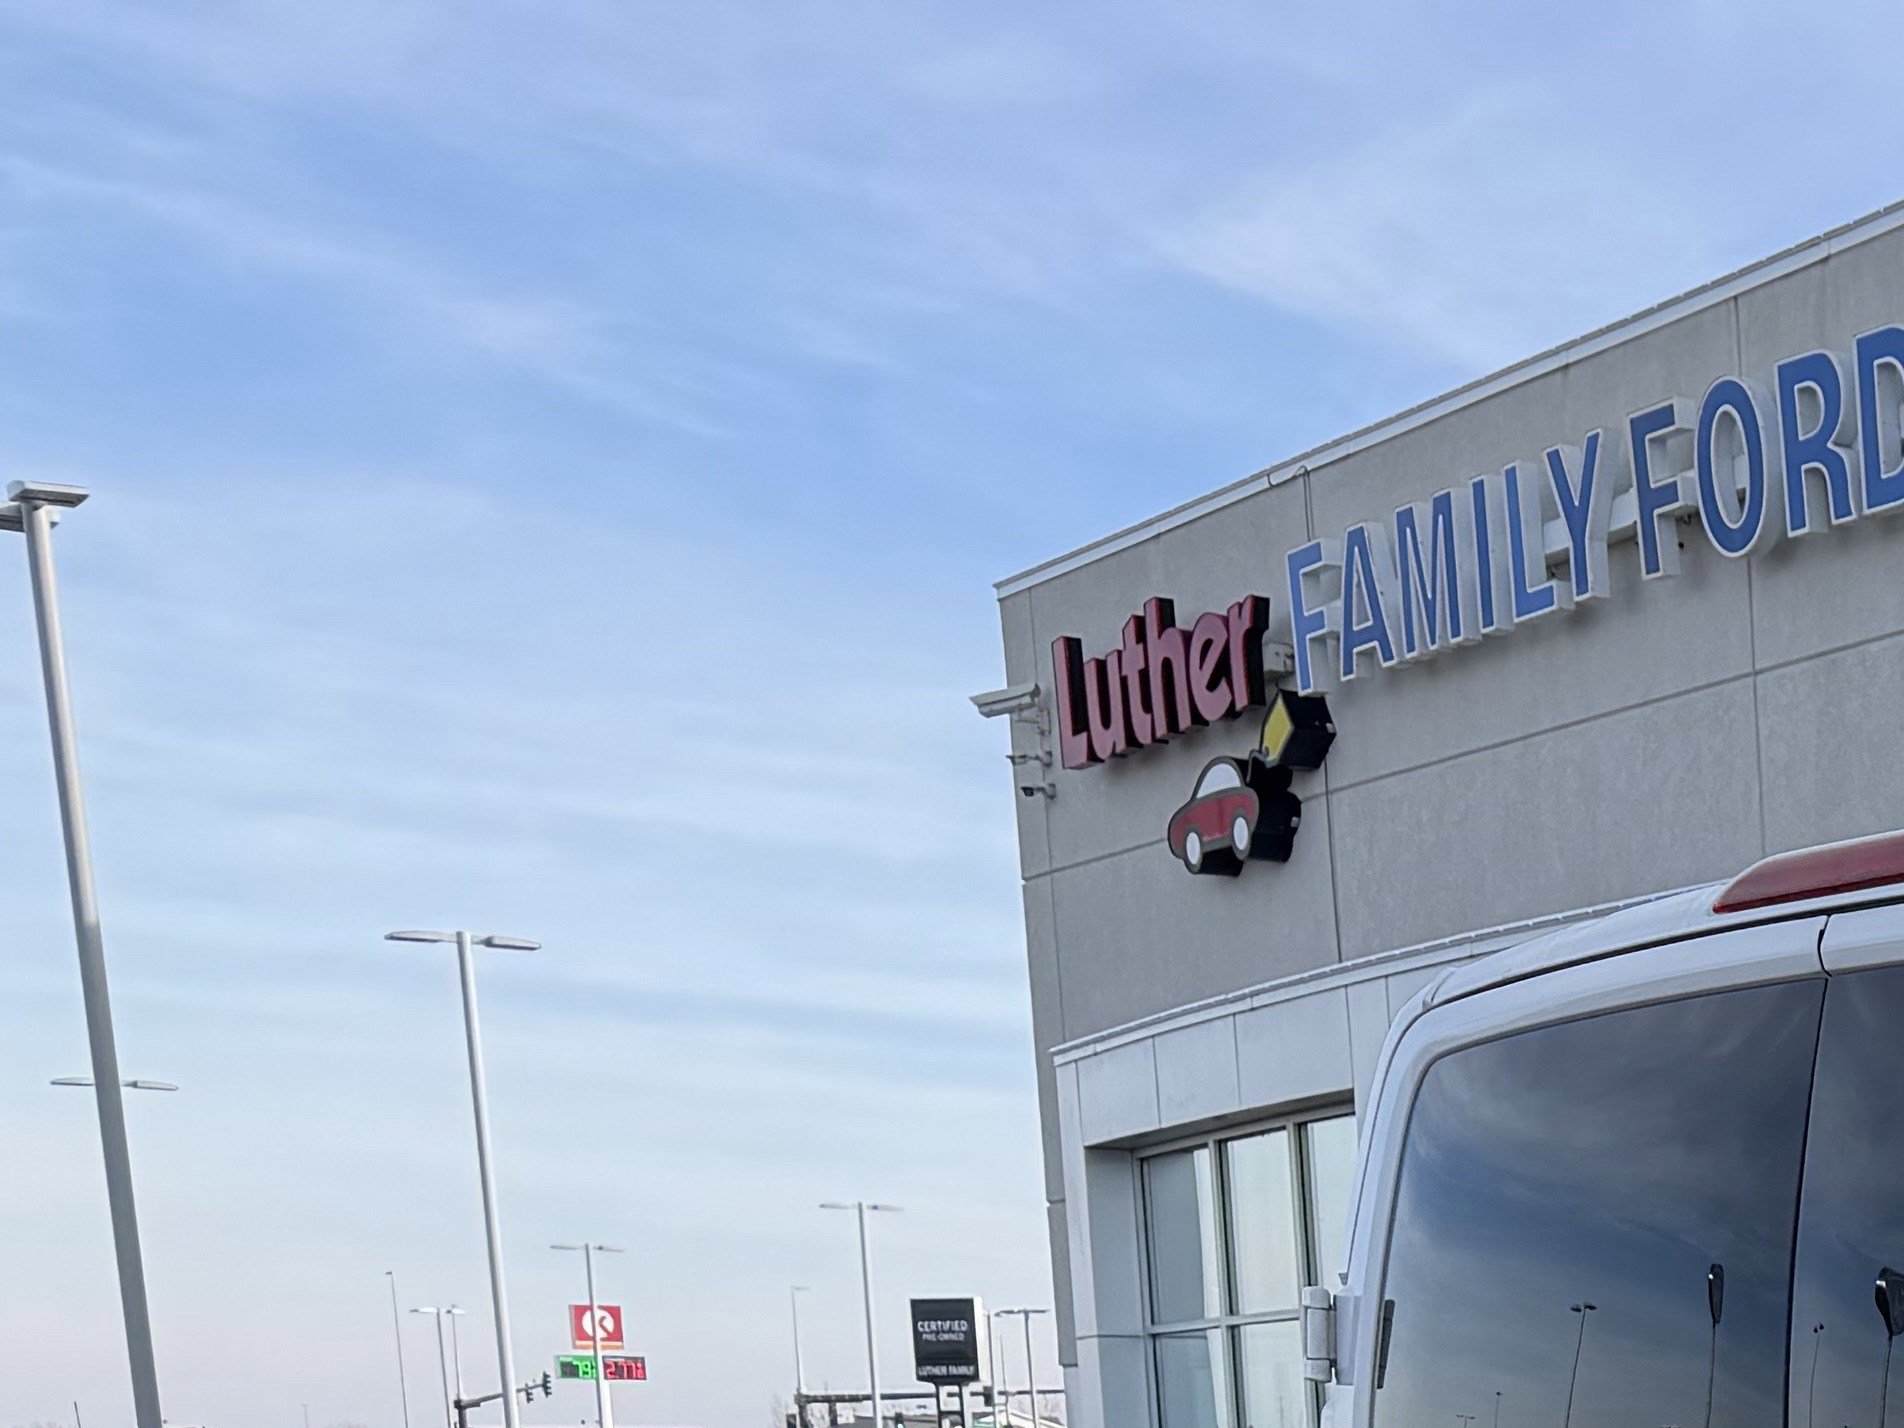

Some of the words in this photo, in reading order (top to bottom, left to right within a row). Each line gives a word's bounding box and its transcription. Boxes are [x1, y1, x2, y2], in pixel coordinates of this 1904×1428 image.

[1052, 595, 1270, 770] Luther
[1286, 429, 1610, 696] FAMILY
[917, 1320, 968, 1332] CERTIFIED
